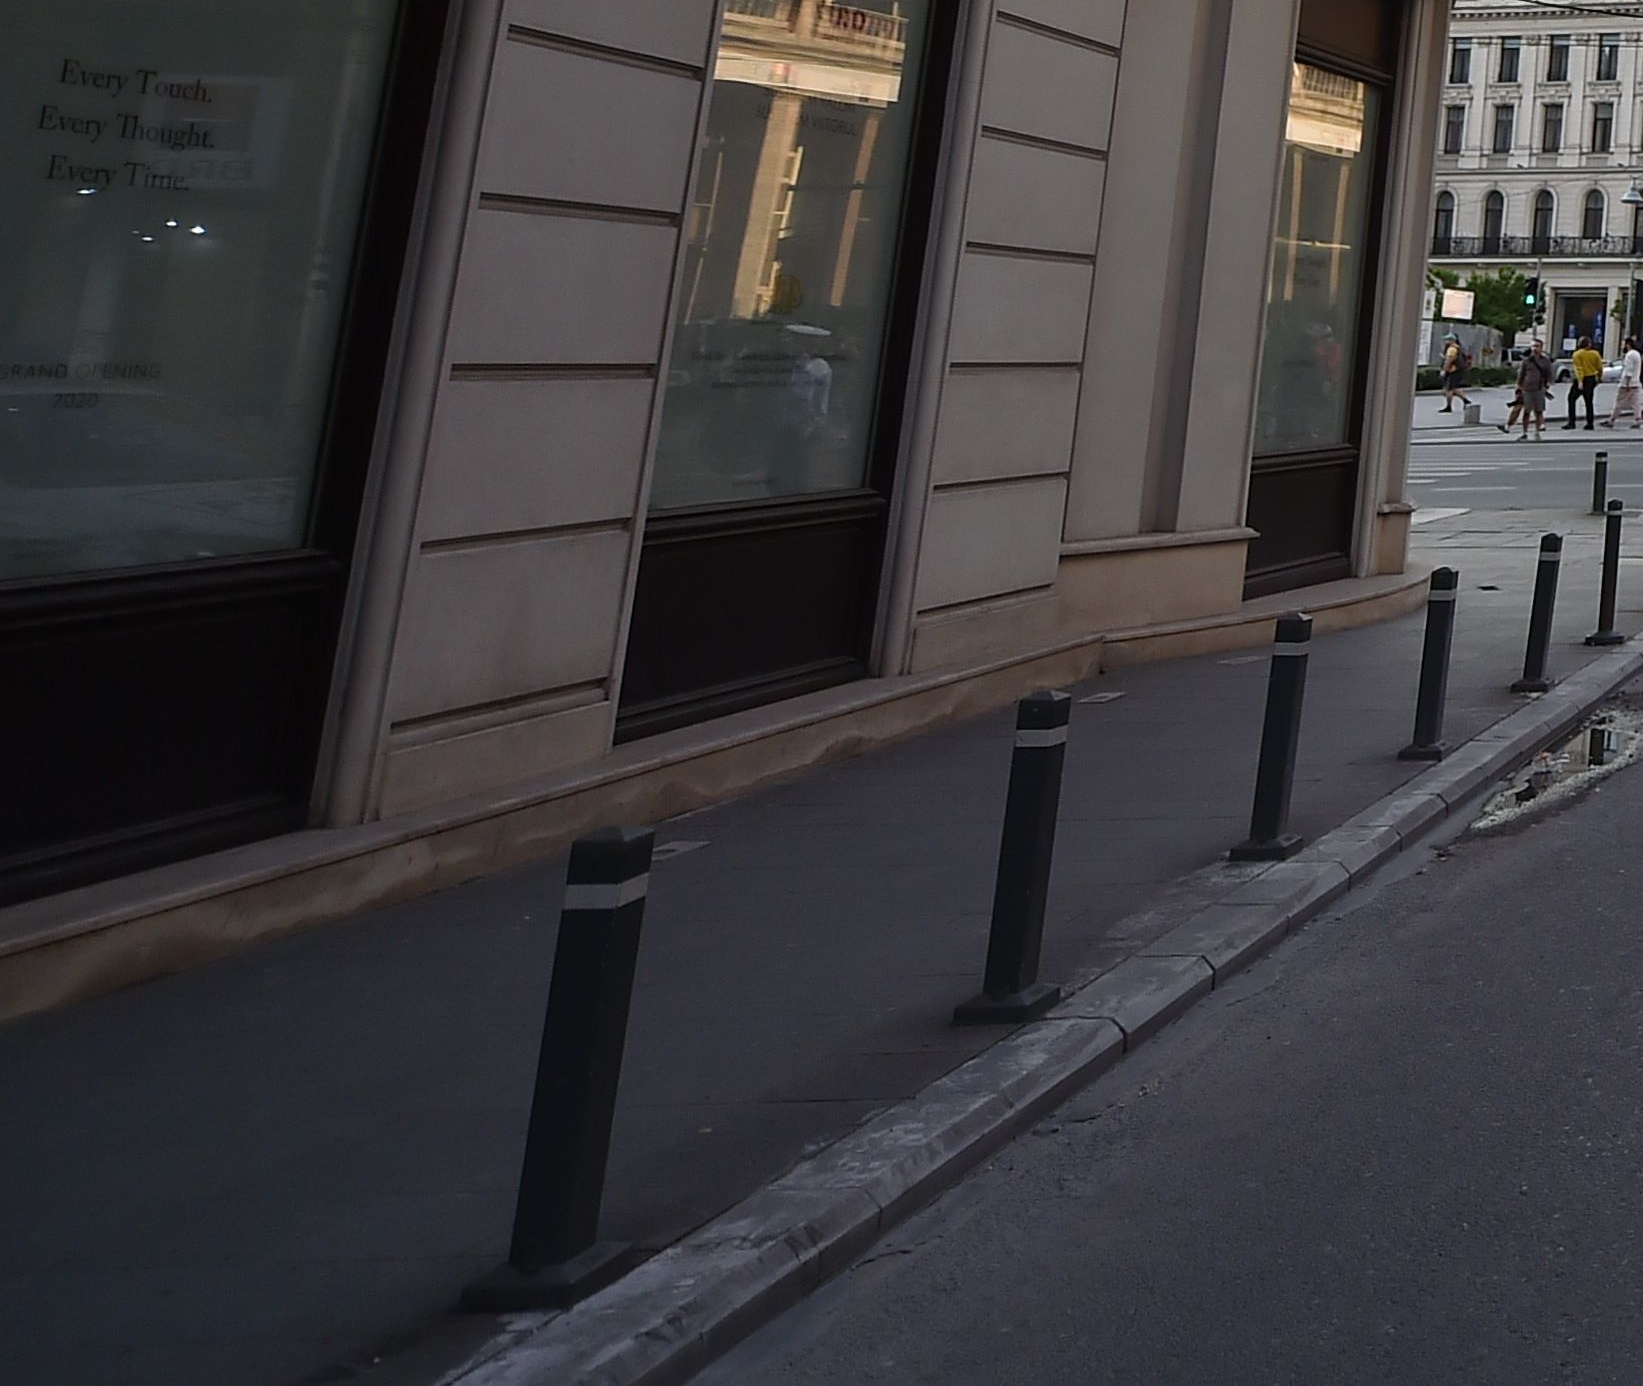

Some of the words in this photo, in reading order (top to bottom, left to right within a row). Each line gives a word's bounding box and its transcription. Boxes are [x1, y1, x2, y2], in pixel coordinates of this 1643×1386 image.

[60, 59, 129, 98] Every
[137, 69, 212, 103] Touch.
[37, 104, 109, 143] Every
[117, 112, 214, 151] Thought.
[46, 155, 117, 193] Every
[124, 161, 190, 191] Time.
[76, 363, 161, 380] OPENING
